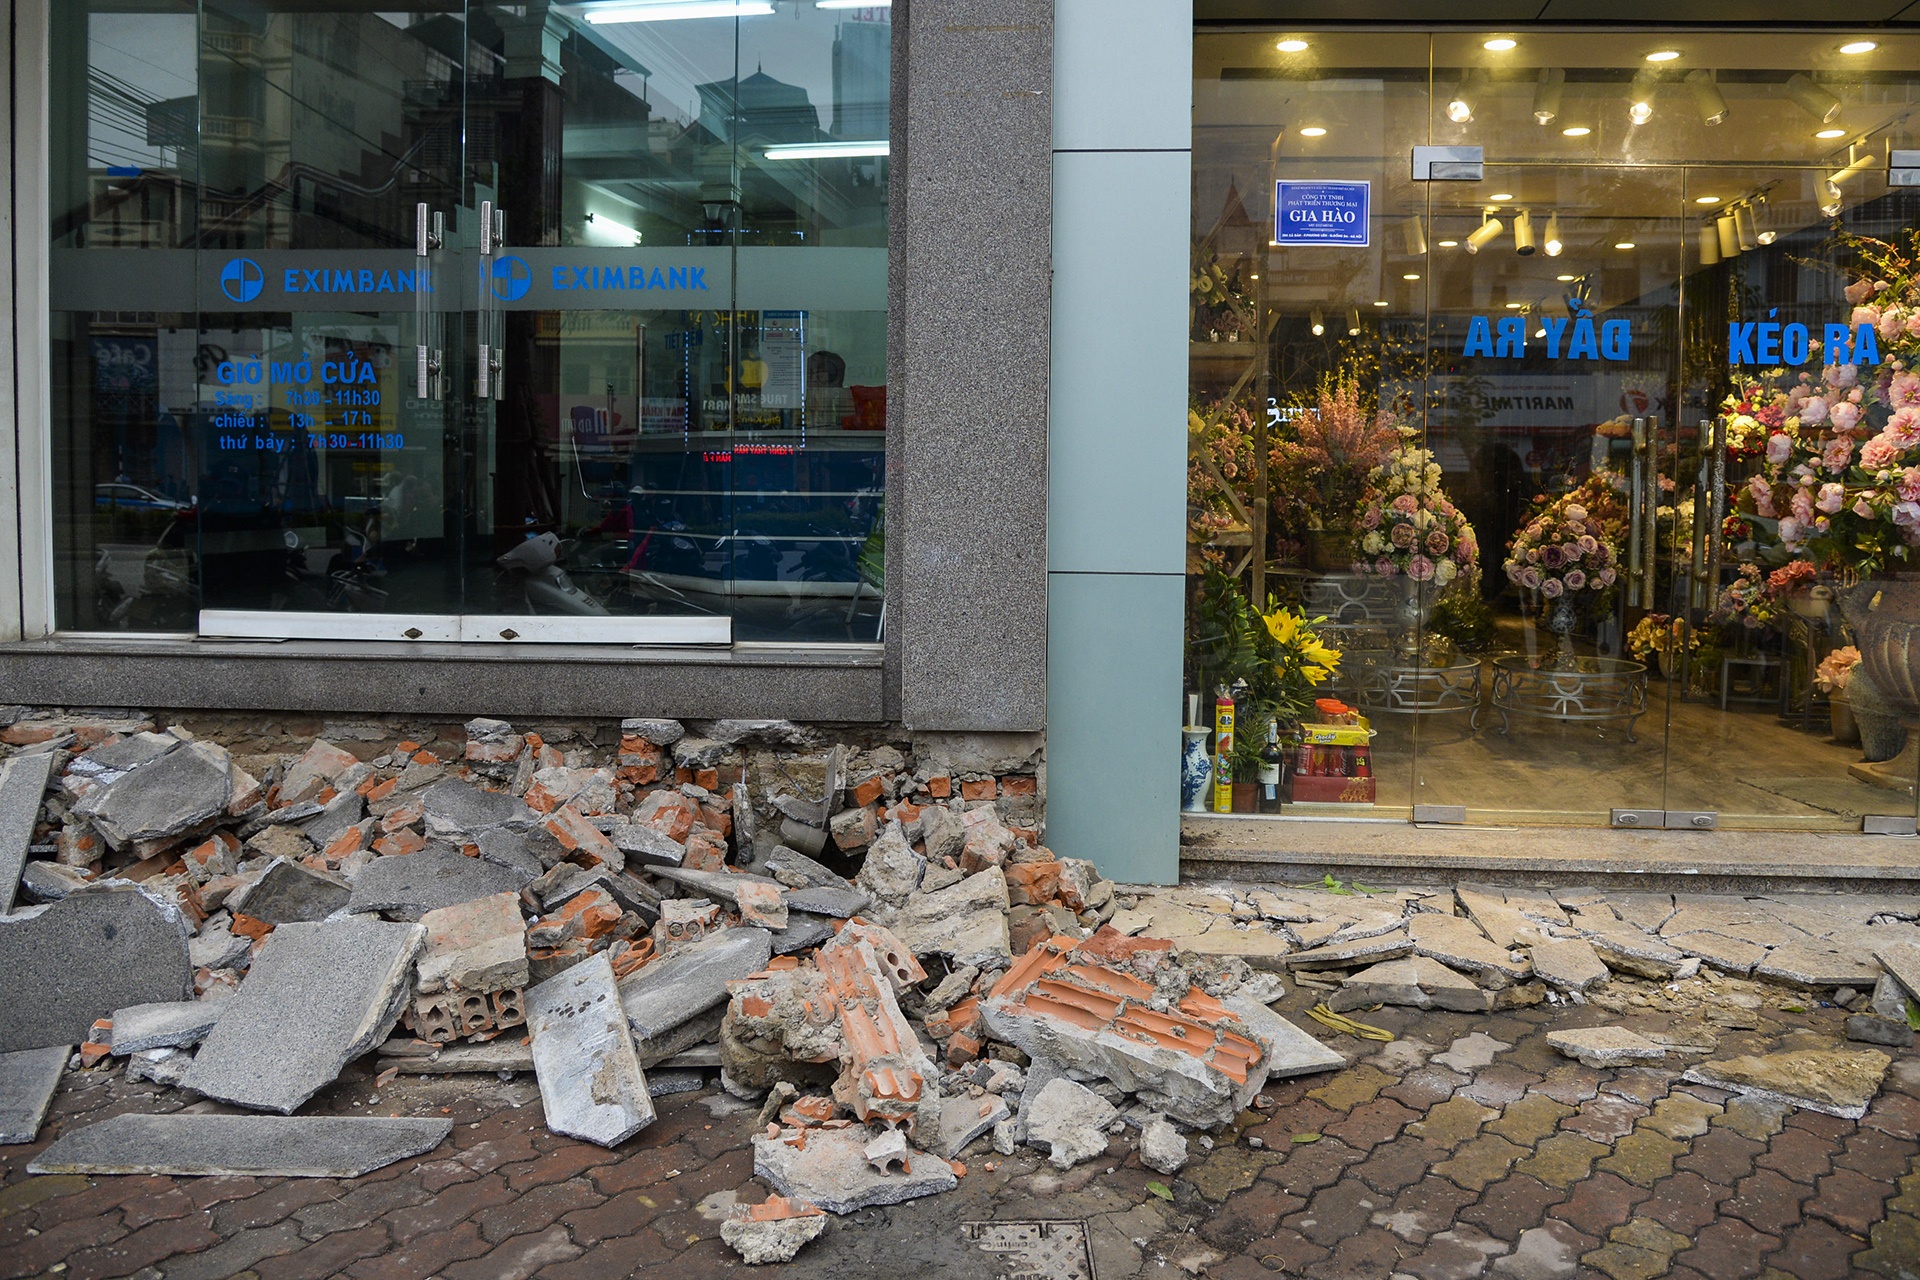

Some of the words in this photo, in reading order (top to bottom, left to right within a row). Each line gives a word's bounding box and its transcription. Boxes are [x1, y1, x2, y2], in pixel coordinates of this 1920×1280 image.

[1289, 210, 1318, 222] GIA
[1322, 208, 1356, 223] HÀO
[284, 268, 435, 293] EXIMBANK
[551, 265, 710, 291] EXIMBANK
[1728, 307, 1809, 366] KÉO
[1823, 322, 1882, 366] RA
[216, 354, 262, 385] GIỜ
[270, 351, 313, 385] MỞ
[320, 350, 377, 385] CỬA
[214, 412, 255, 428] chiều
[219, 434, 248, 450] thứ
[255, 432, 285, 453] bảy
